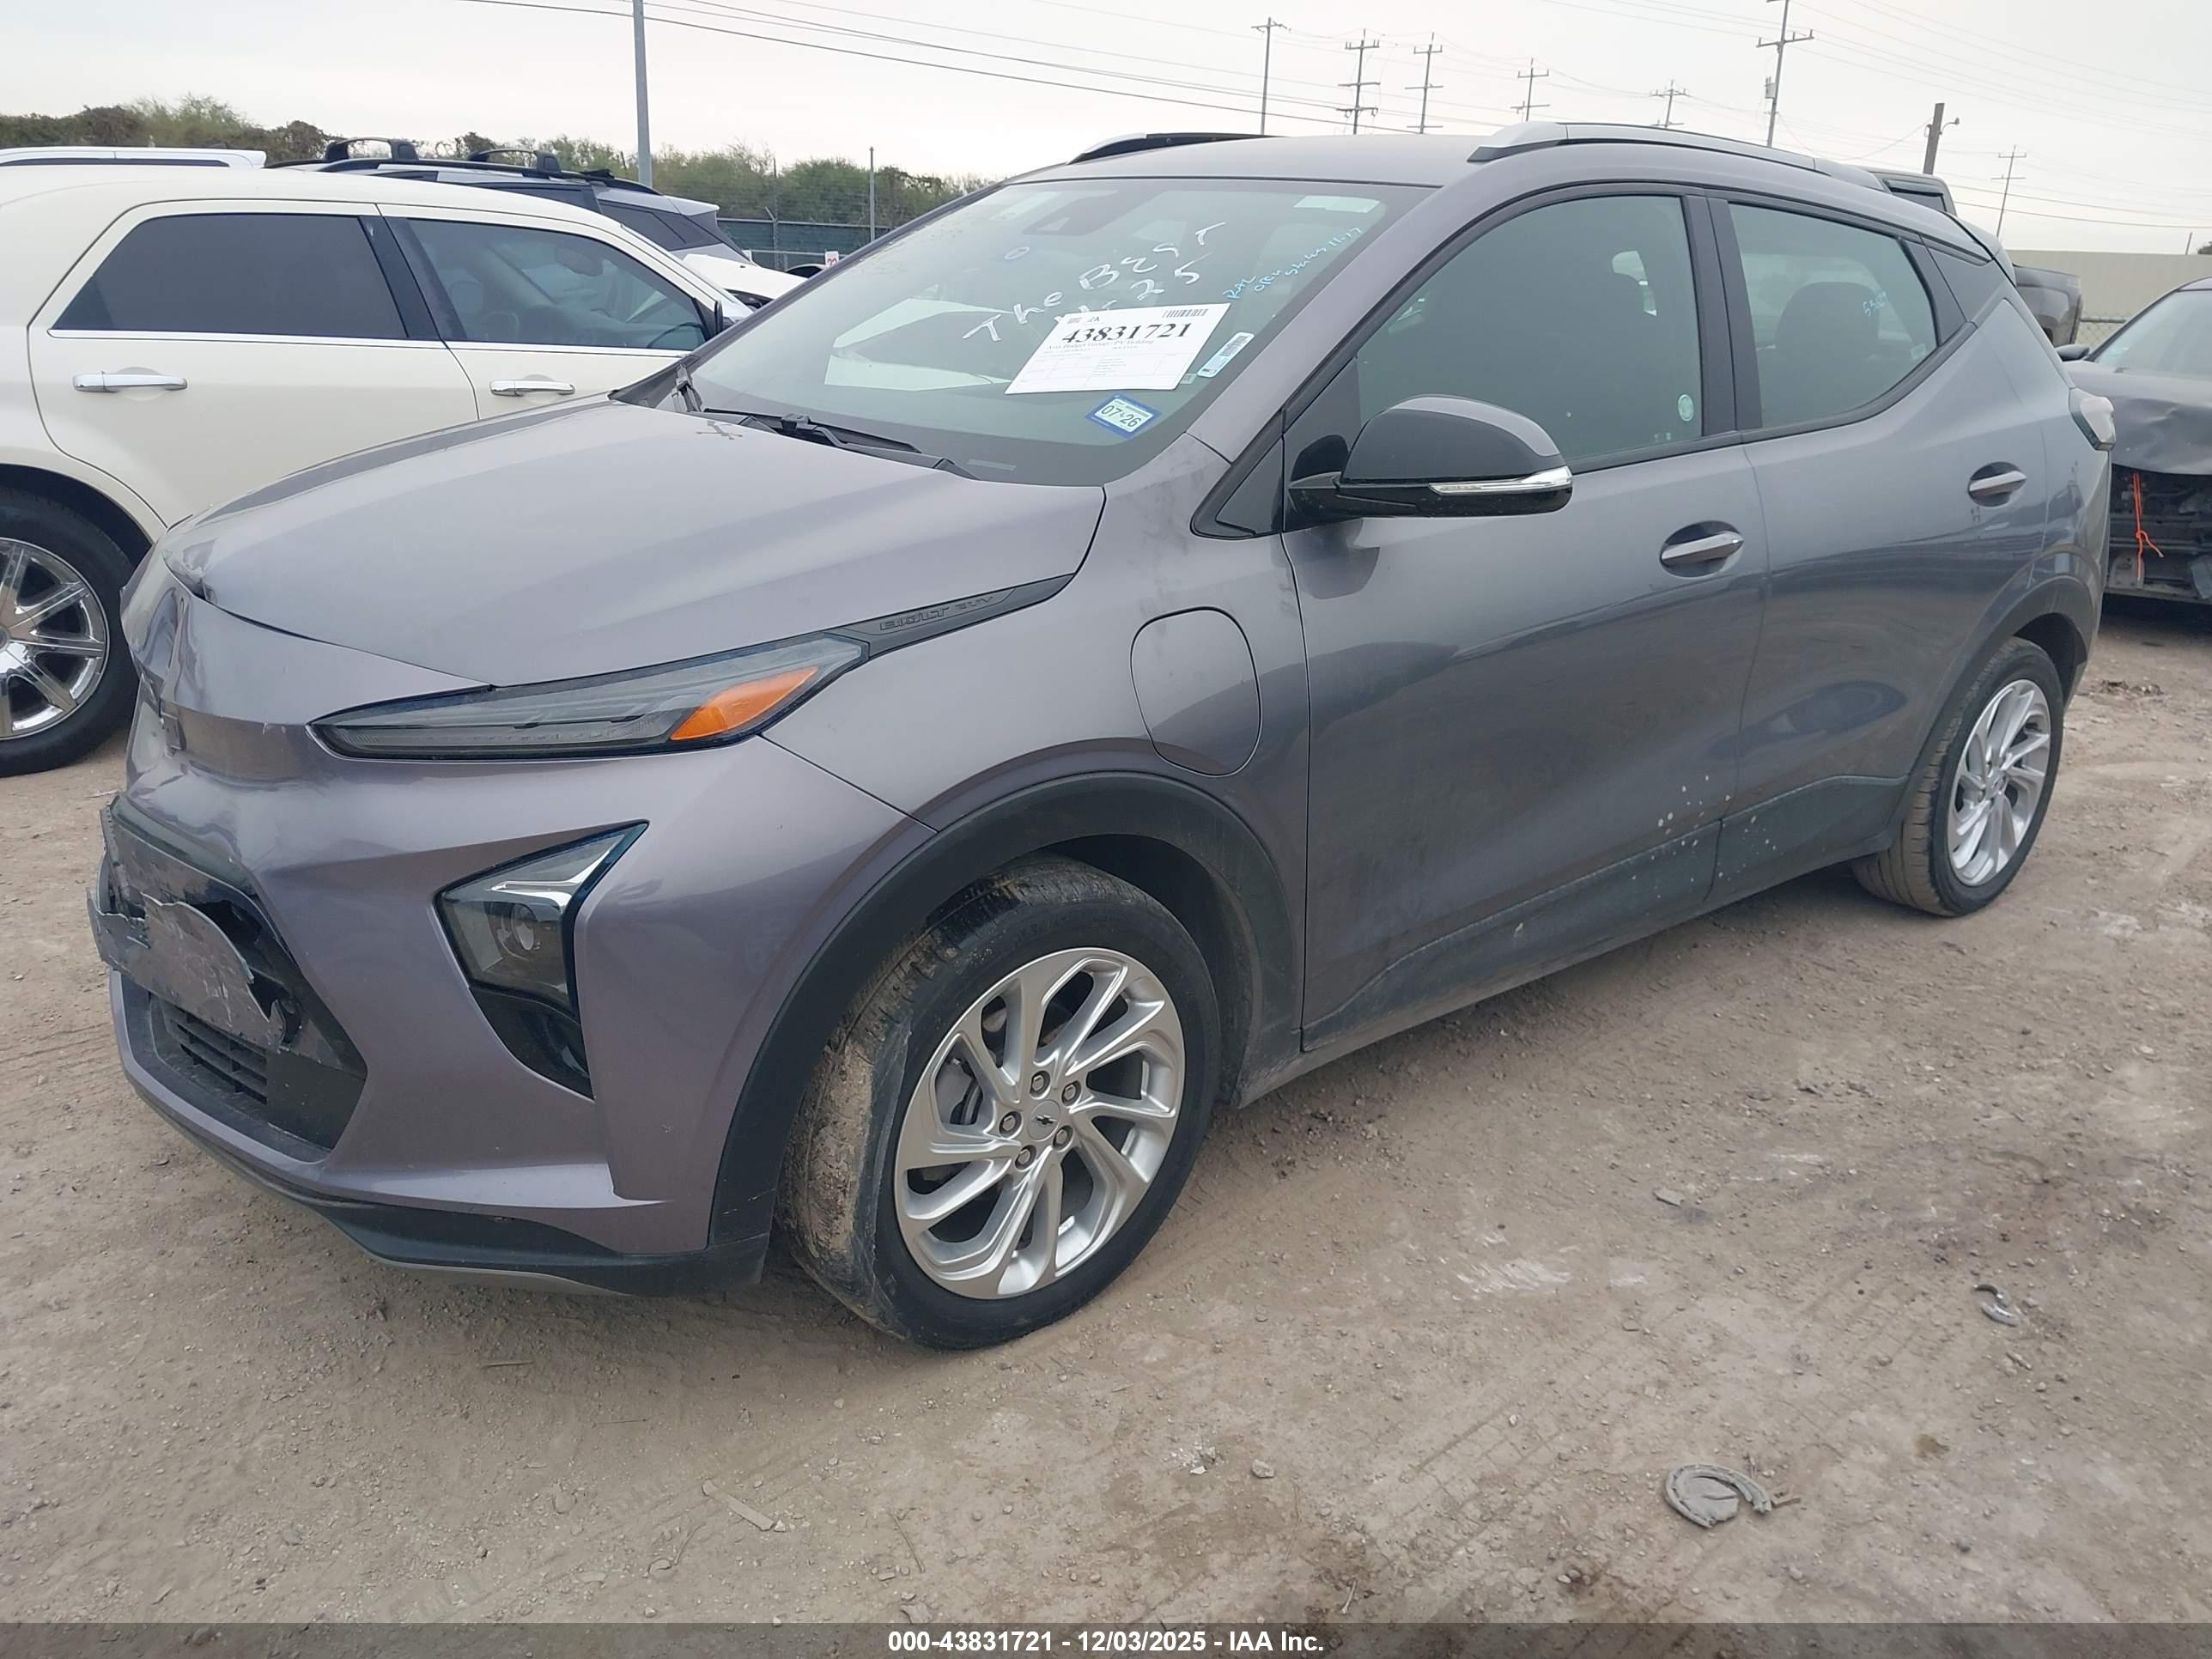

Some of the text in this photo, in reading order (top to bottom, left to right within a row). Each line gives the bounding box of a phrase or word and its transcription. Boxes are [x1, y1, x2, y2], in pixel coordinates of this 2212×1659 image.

[1061, 322, 1192, 343] 43831721
[1101, 404, 1142, 428] 07 26
[879, 606, 950, 631] BOLT
